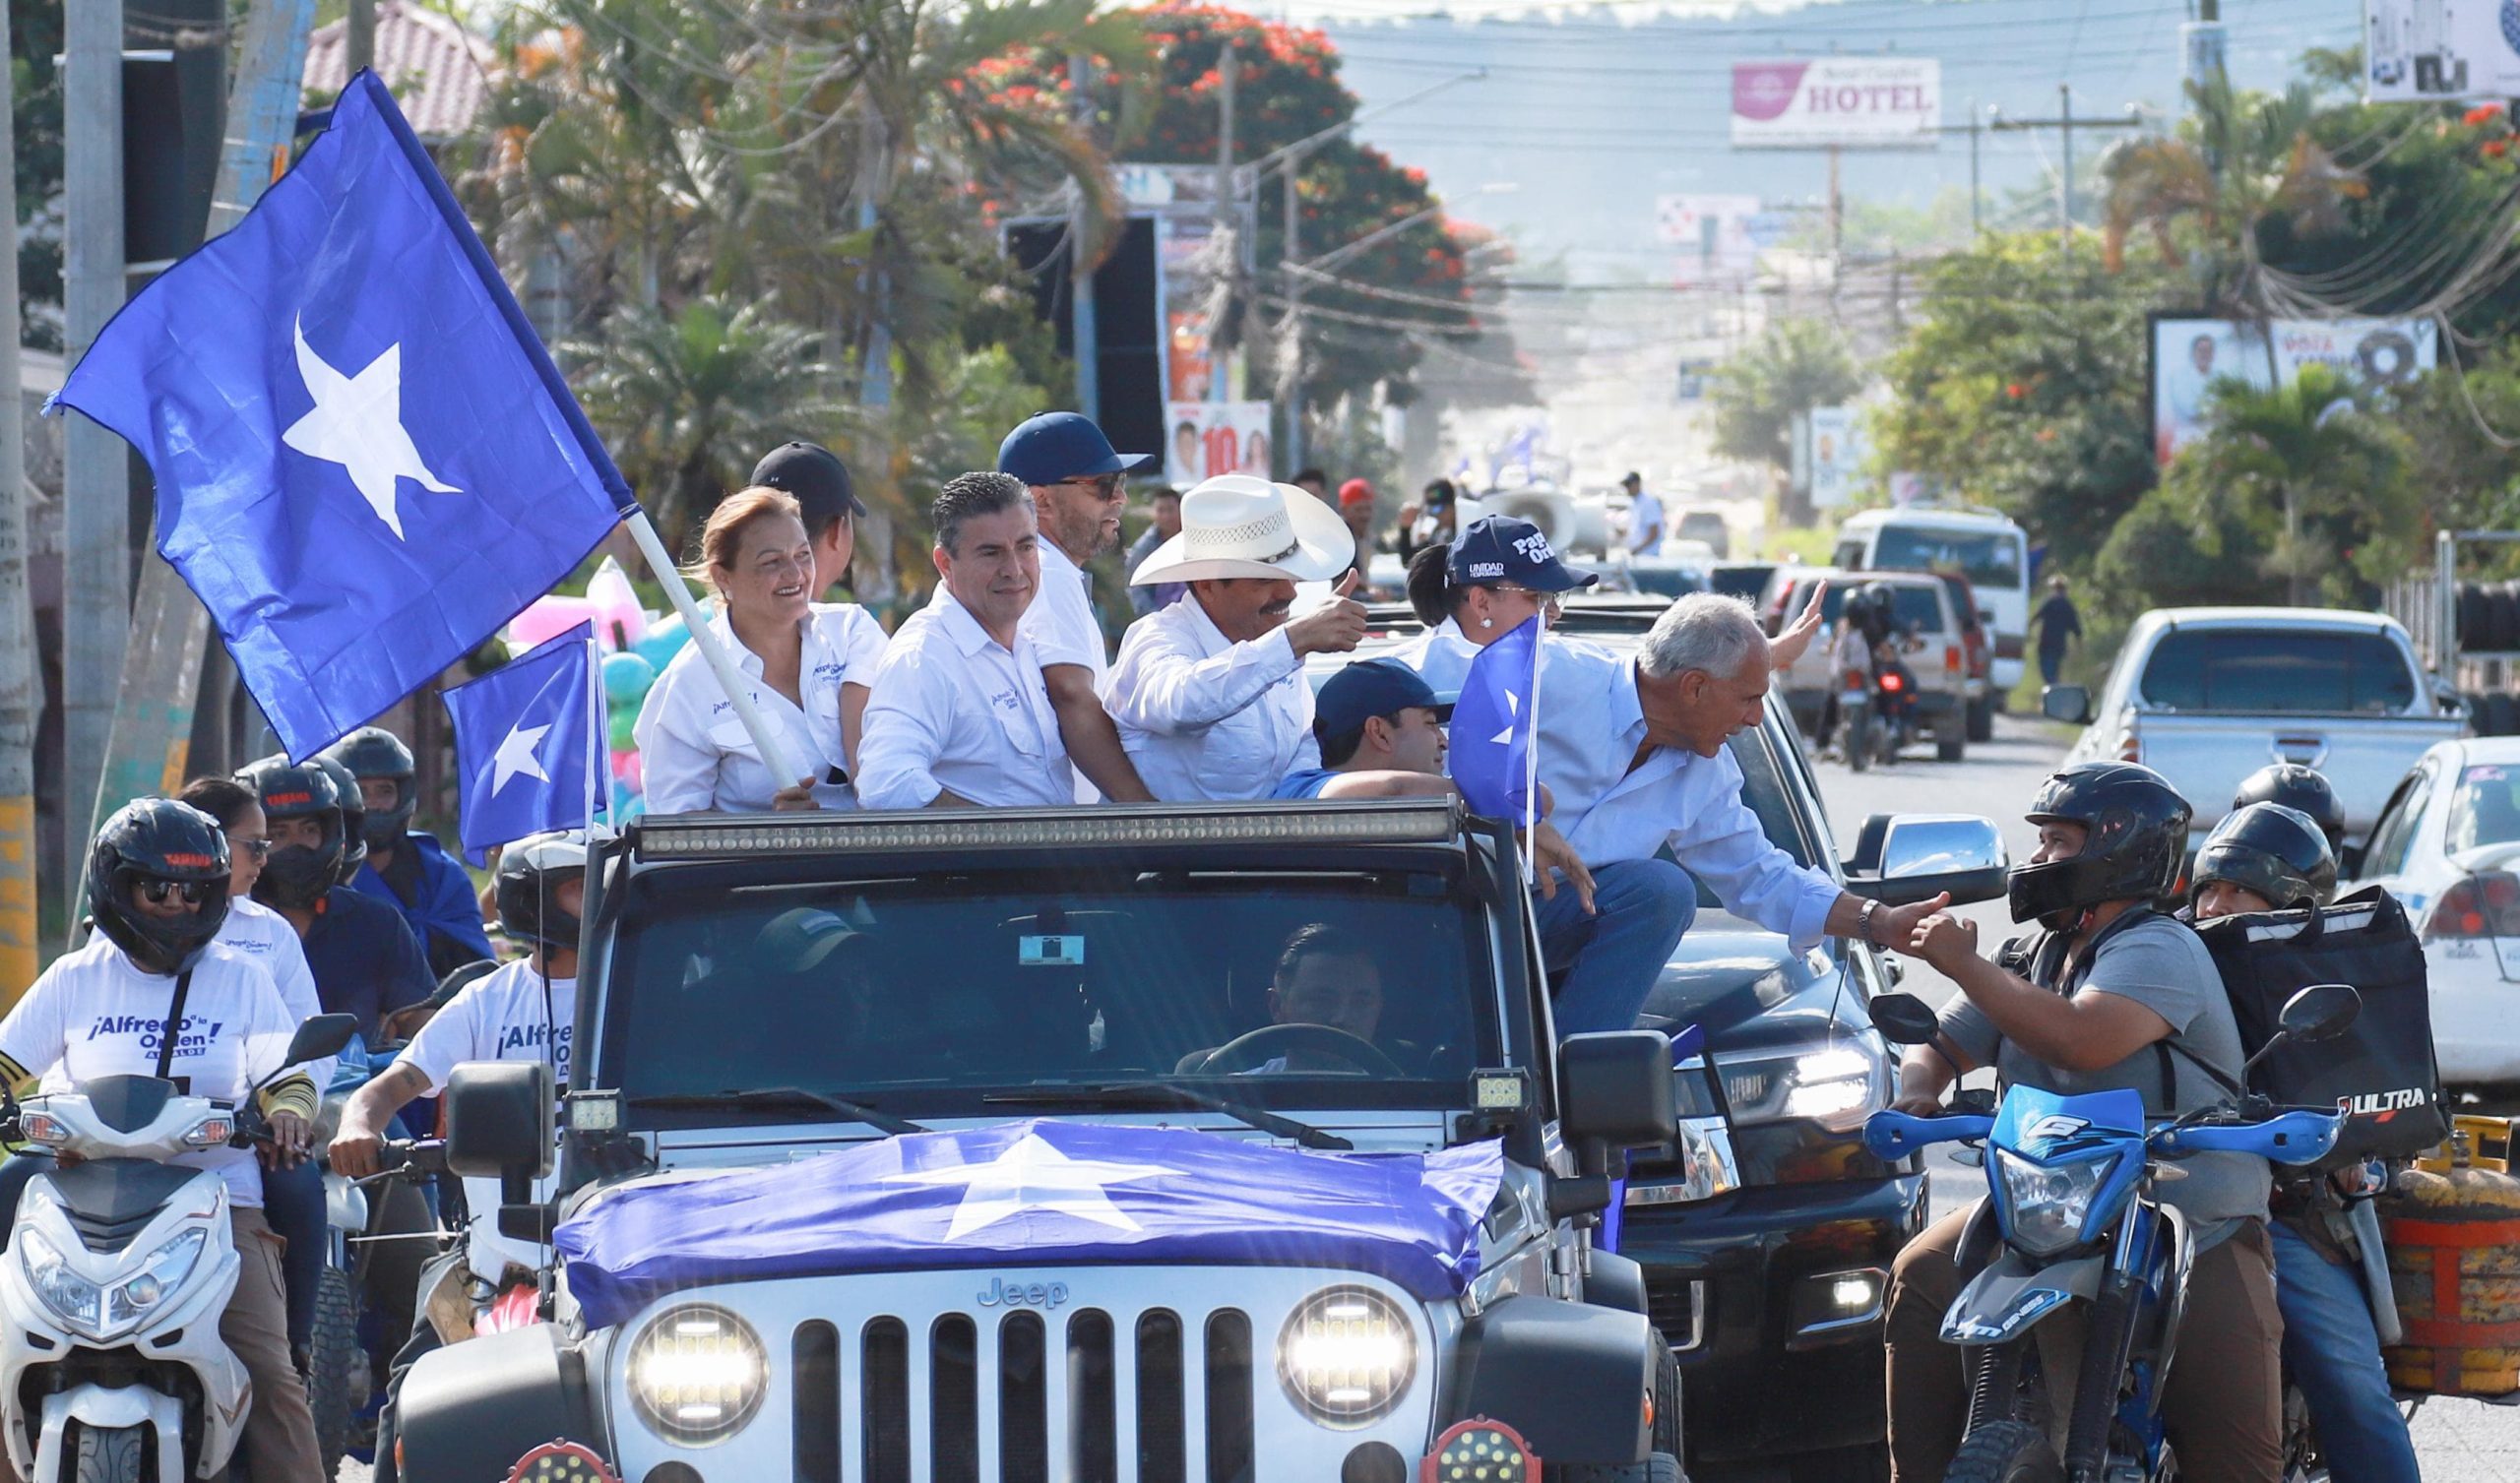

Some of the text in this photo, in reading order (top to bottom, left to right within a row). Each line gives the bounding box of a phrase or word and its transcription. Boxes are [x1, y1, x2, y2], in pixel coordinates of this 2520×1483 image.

[1807, 85, 1934, 114] HOTEL
[1202, 425, 1238, 477] 10
[1512, 531, 1546, 556] Pap
[1469, 562, 1505, 573] UNIDAD
[267, 792, 311, 806] YAMAHA
[163, 852, 213, 867] YAMAHA
[2354, 1087, 2426, 1115] ULTRA
[976, 1277, 1069, 1310] Jeep
